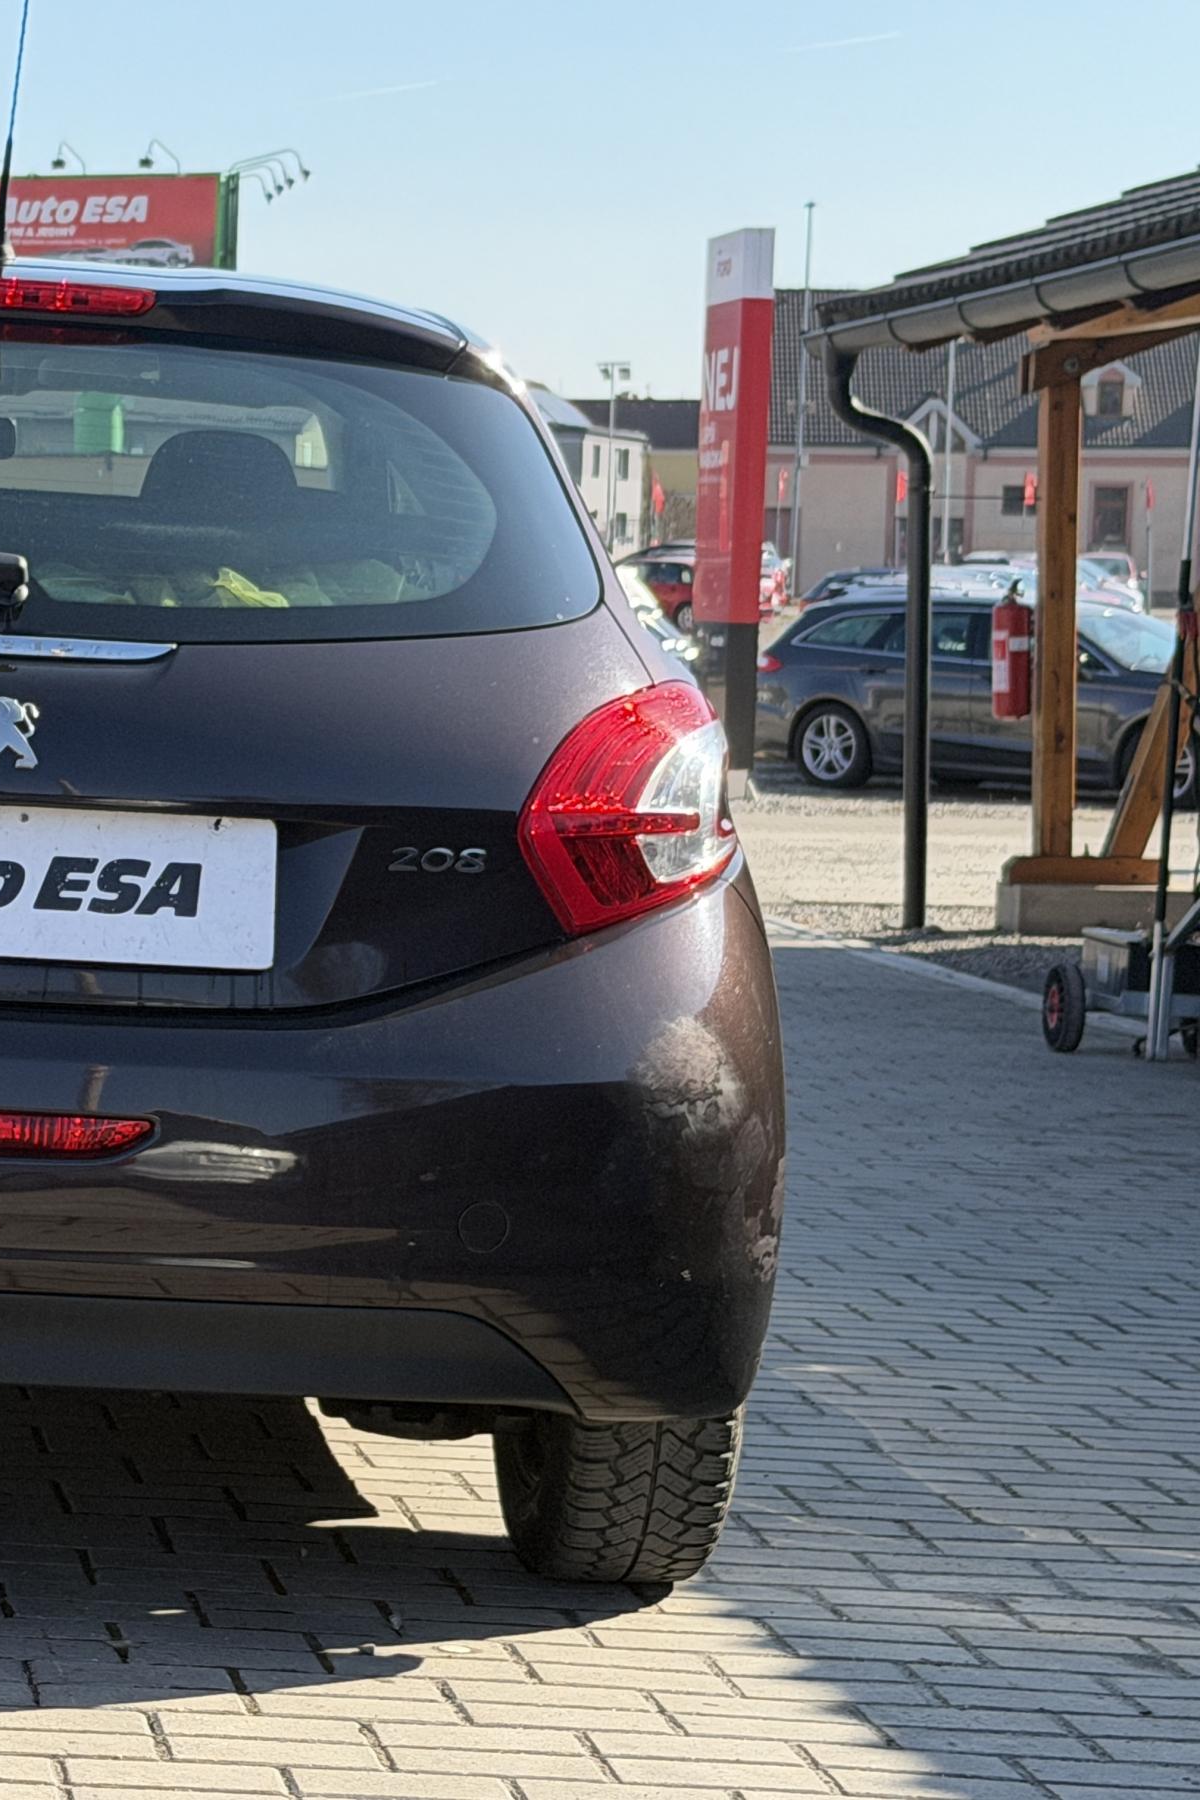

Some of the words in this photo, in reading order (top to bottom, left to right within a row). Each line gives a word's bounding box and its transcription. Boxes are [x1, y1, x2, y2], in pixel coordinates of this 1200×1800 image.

[80, 195, 149, 223] ESA
[701, 347, 738, 411] NEJ
[387, 846, 487, 874] 208
[33, 855, 202, 917] ESA
